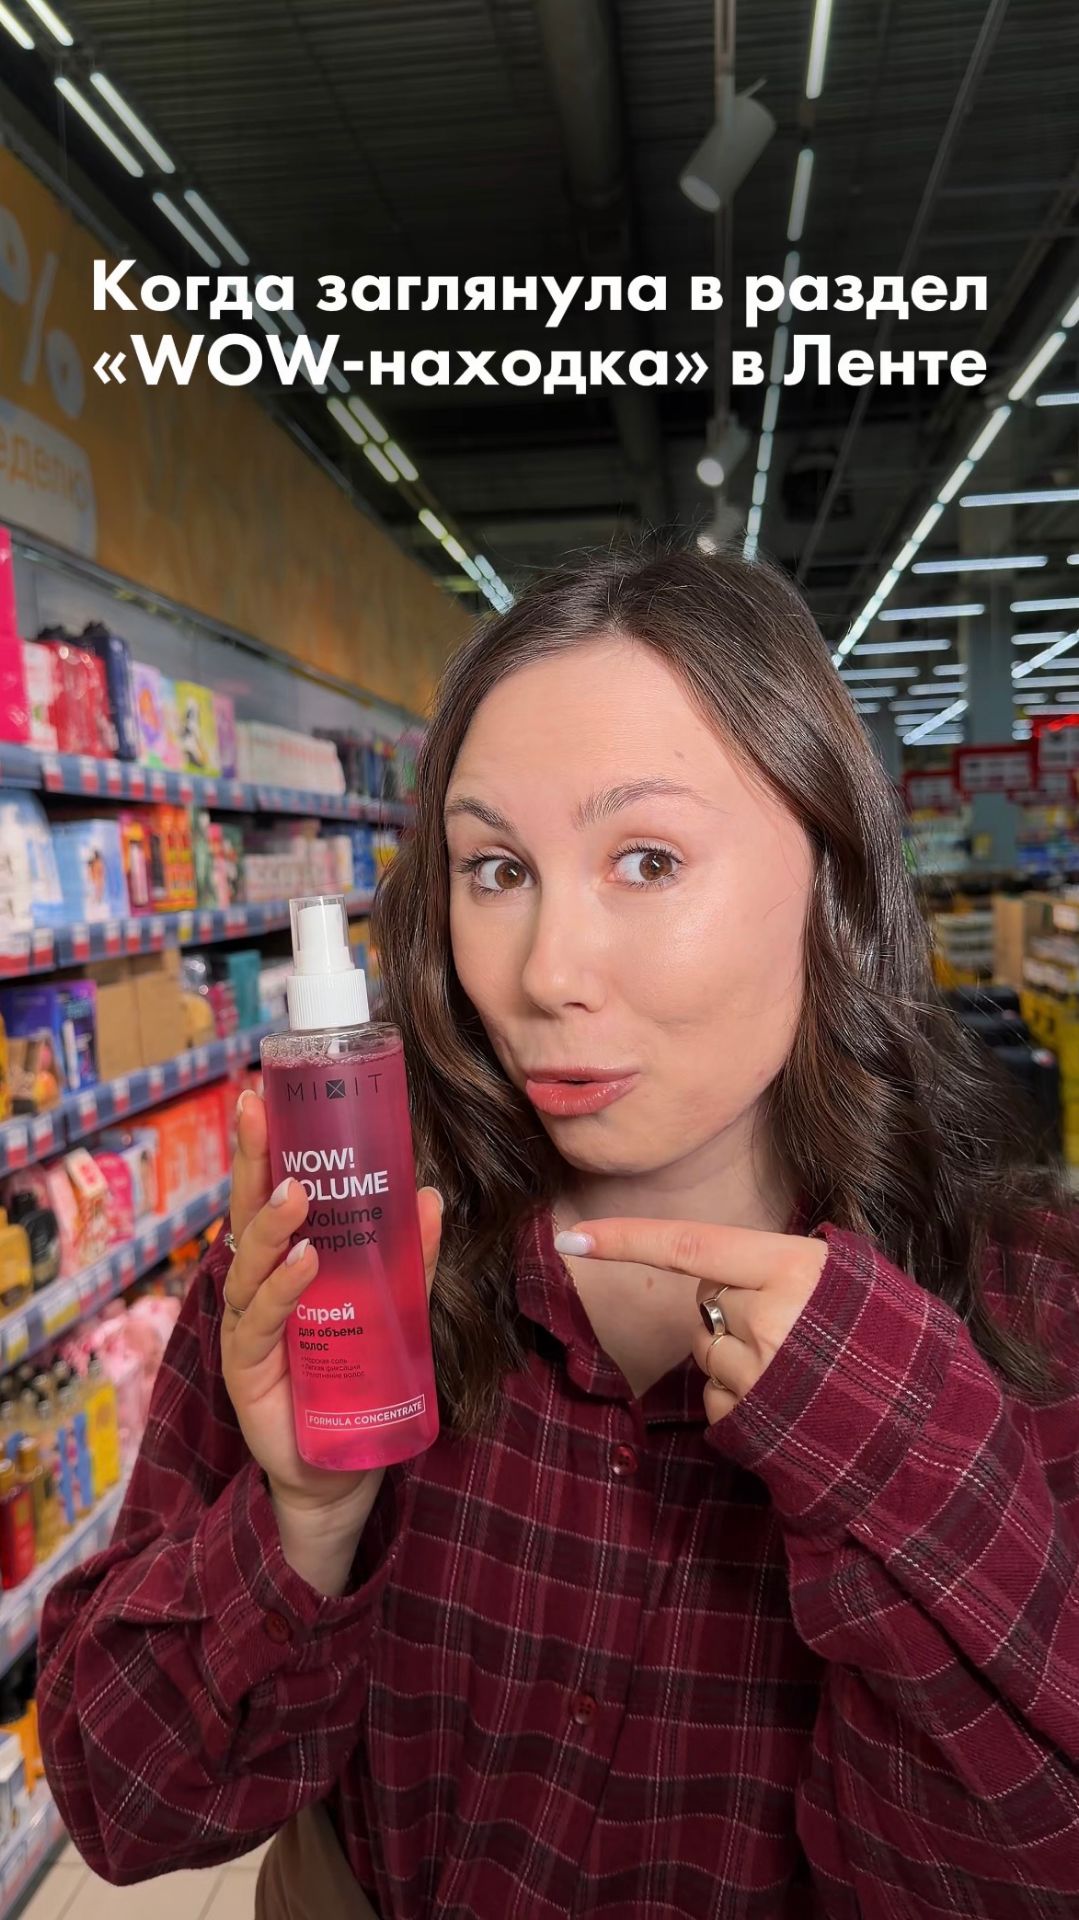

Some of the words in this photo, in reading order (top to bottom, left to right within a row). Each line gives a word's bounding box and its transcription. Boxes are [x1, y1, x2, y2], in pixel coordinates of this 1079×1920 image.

[281, 1147, 355, 1173] WOW!
[299, 1170, 389, 1201] OLUME
[290, 1230, 377, 1252] Cmplex
[296, 1302, 355, 1325] Спрей
[298, 1327, 315, 1337] для
[317, 1326, 364, 1338] объема
[300, 1340, 329, 1351] волос
[309, 1415, 352, 1427] FORMULA
[354, 1400, 423, 1426] CONCENTRATE
